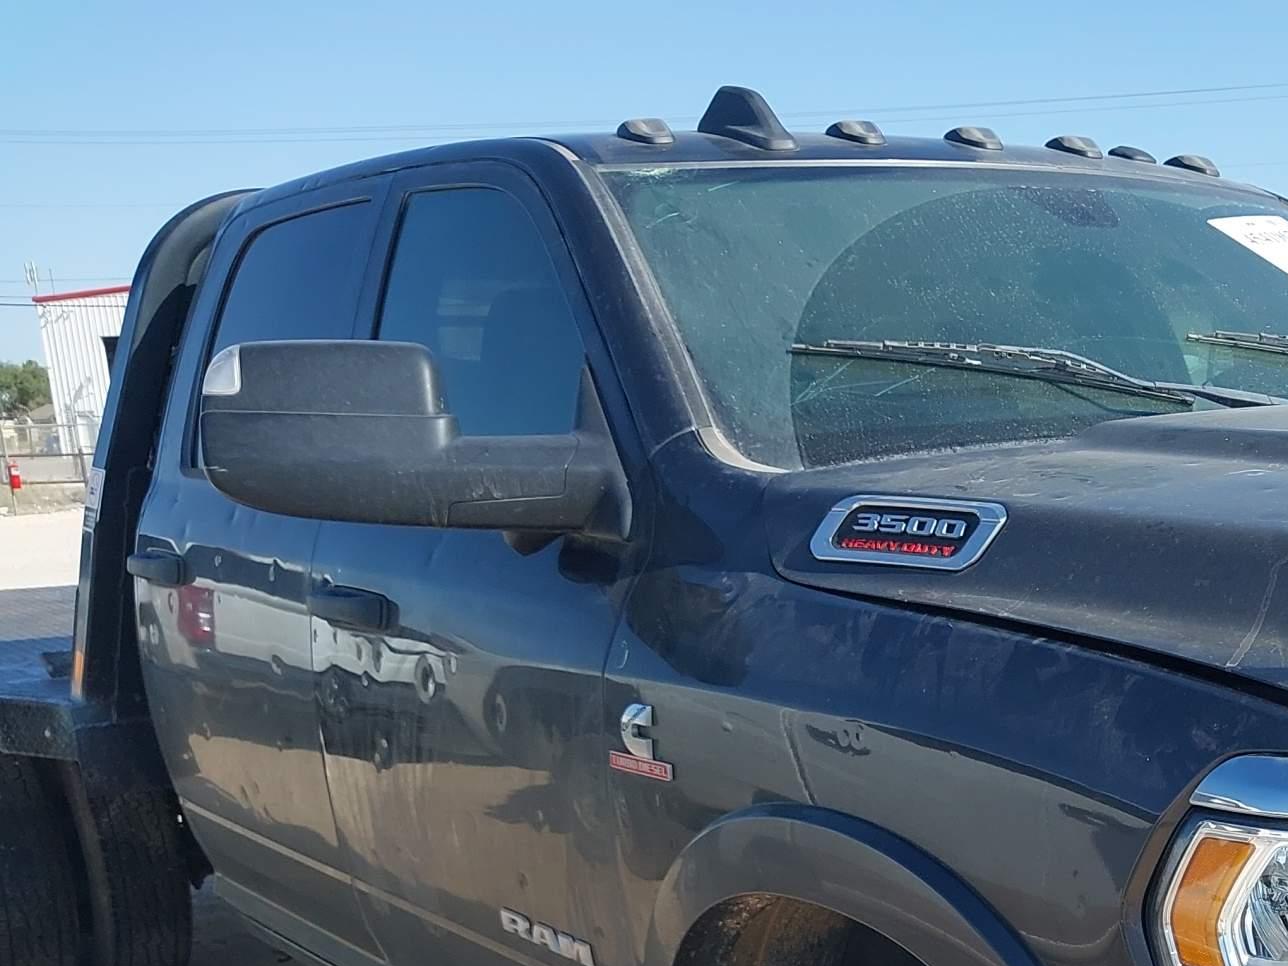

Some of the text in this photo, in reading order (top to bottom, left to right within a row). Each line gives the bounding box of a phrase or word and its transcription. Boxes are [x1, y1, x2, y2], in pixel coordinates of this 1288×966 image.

[852, 513, 967, 538] 3500
[840, 538, 955, 557] HEAVY DUTY
